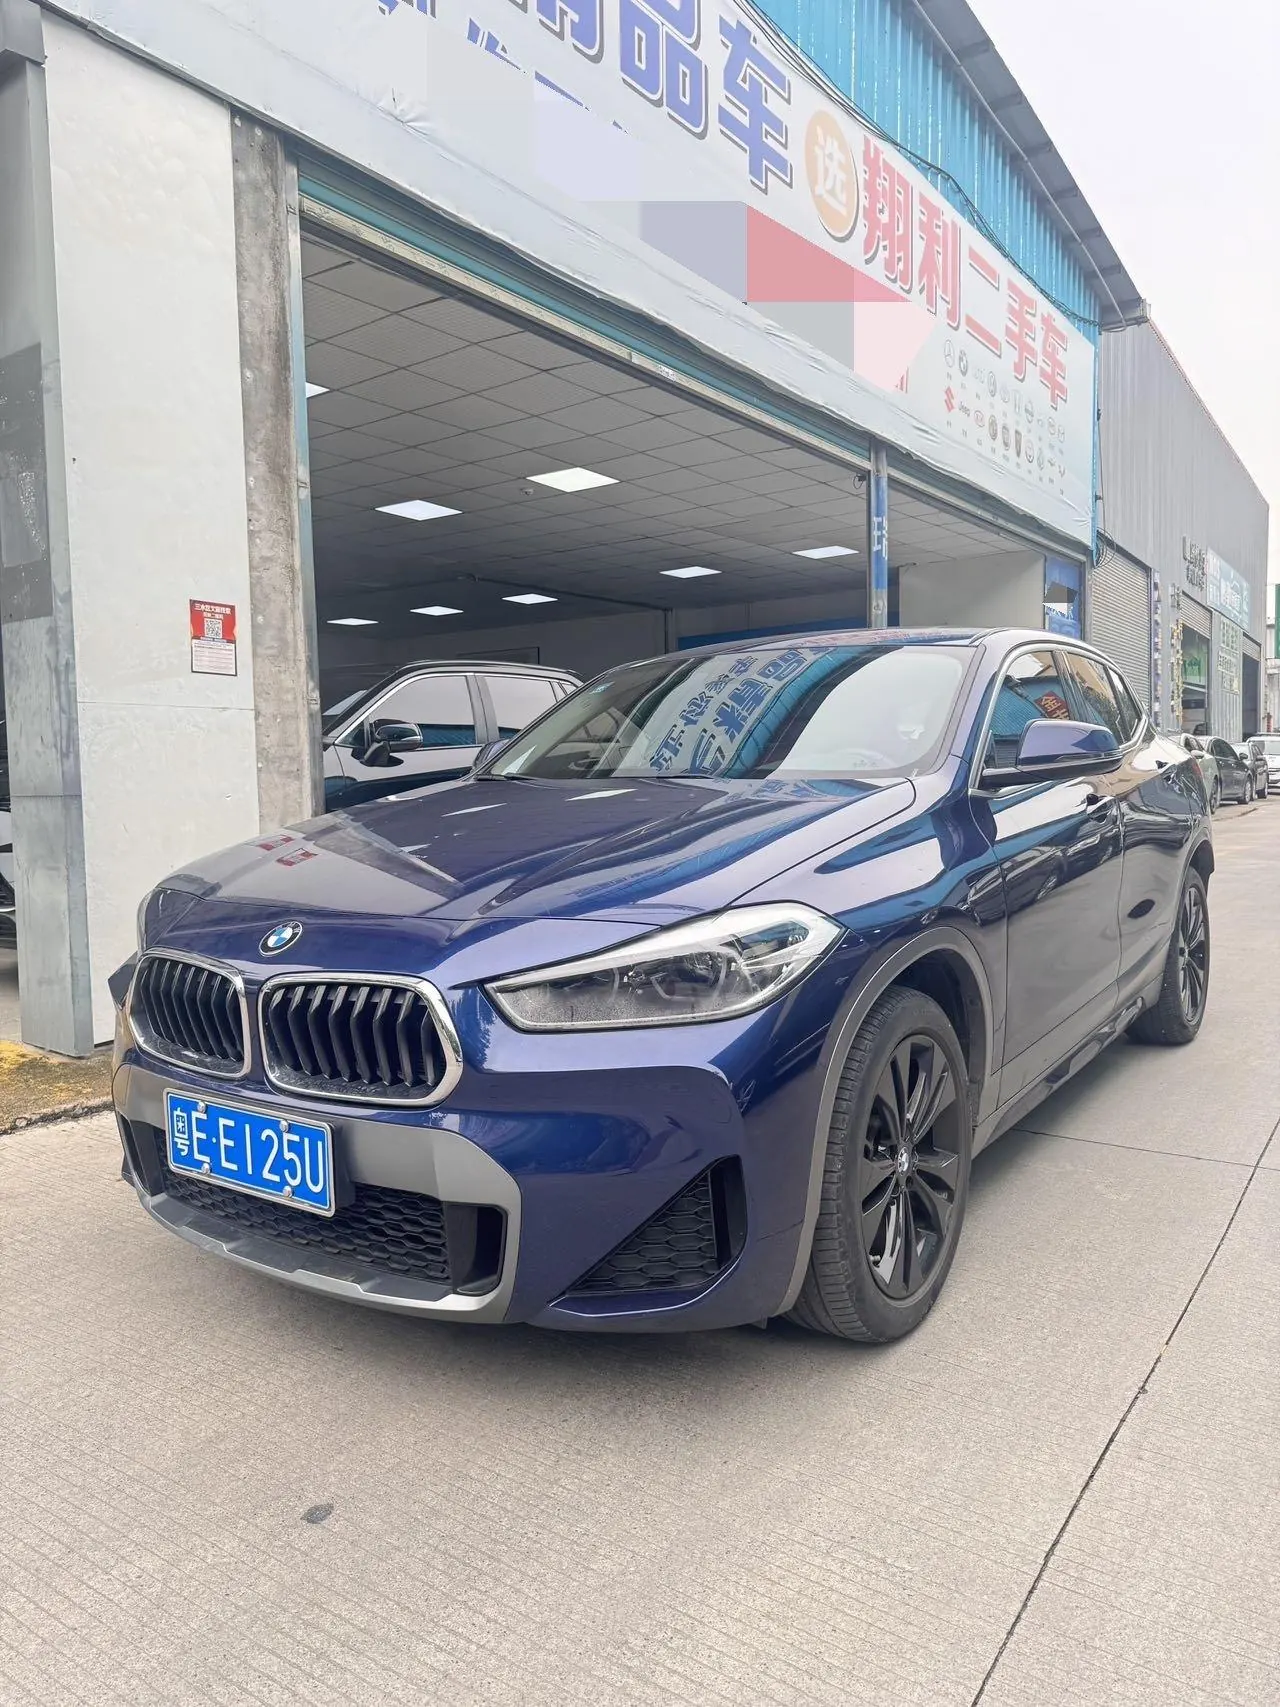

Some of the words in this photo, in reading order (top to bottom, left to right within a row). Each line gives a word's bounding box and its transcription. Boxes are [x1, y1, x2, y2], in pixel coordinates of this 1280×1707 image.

[814, 126, 848, 215] 选
[862, 132, 1068, 411] 翔利二手车
